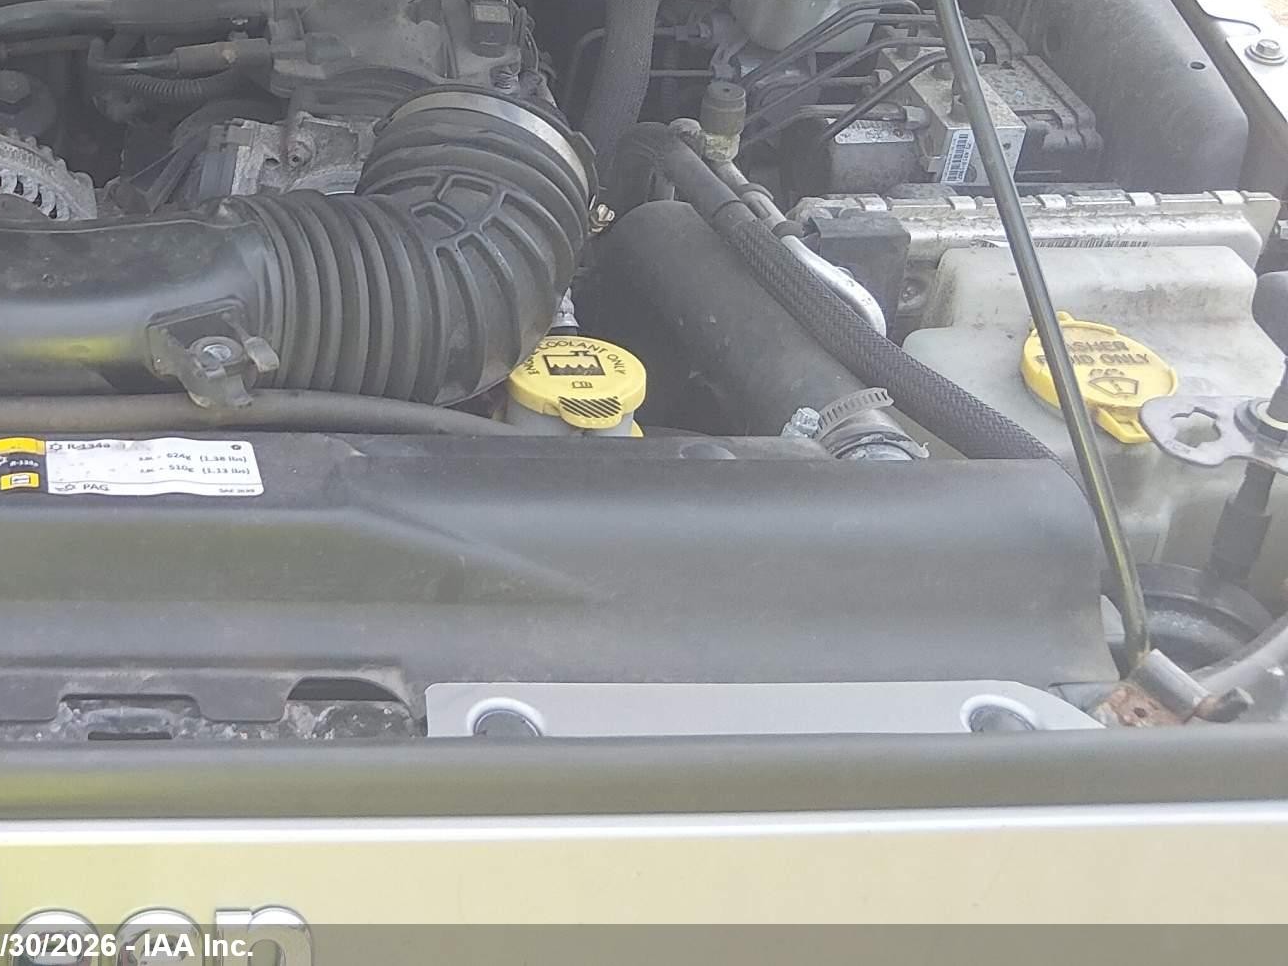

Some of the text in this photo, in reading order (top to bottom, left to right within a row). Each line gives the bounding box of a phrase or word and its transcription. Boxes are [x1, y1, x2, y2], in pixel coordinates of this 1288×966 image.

[1066, 341, 1129, 352] SHER
[537, 339, 609, 354] COOLANT
[607, 354, 627, 375] ONLY
[1099, 353, 1150, 364] ONLY
[66, 442, 111, 450] R-134a
[82, 483, 111, 491] PAG
